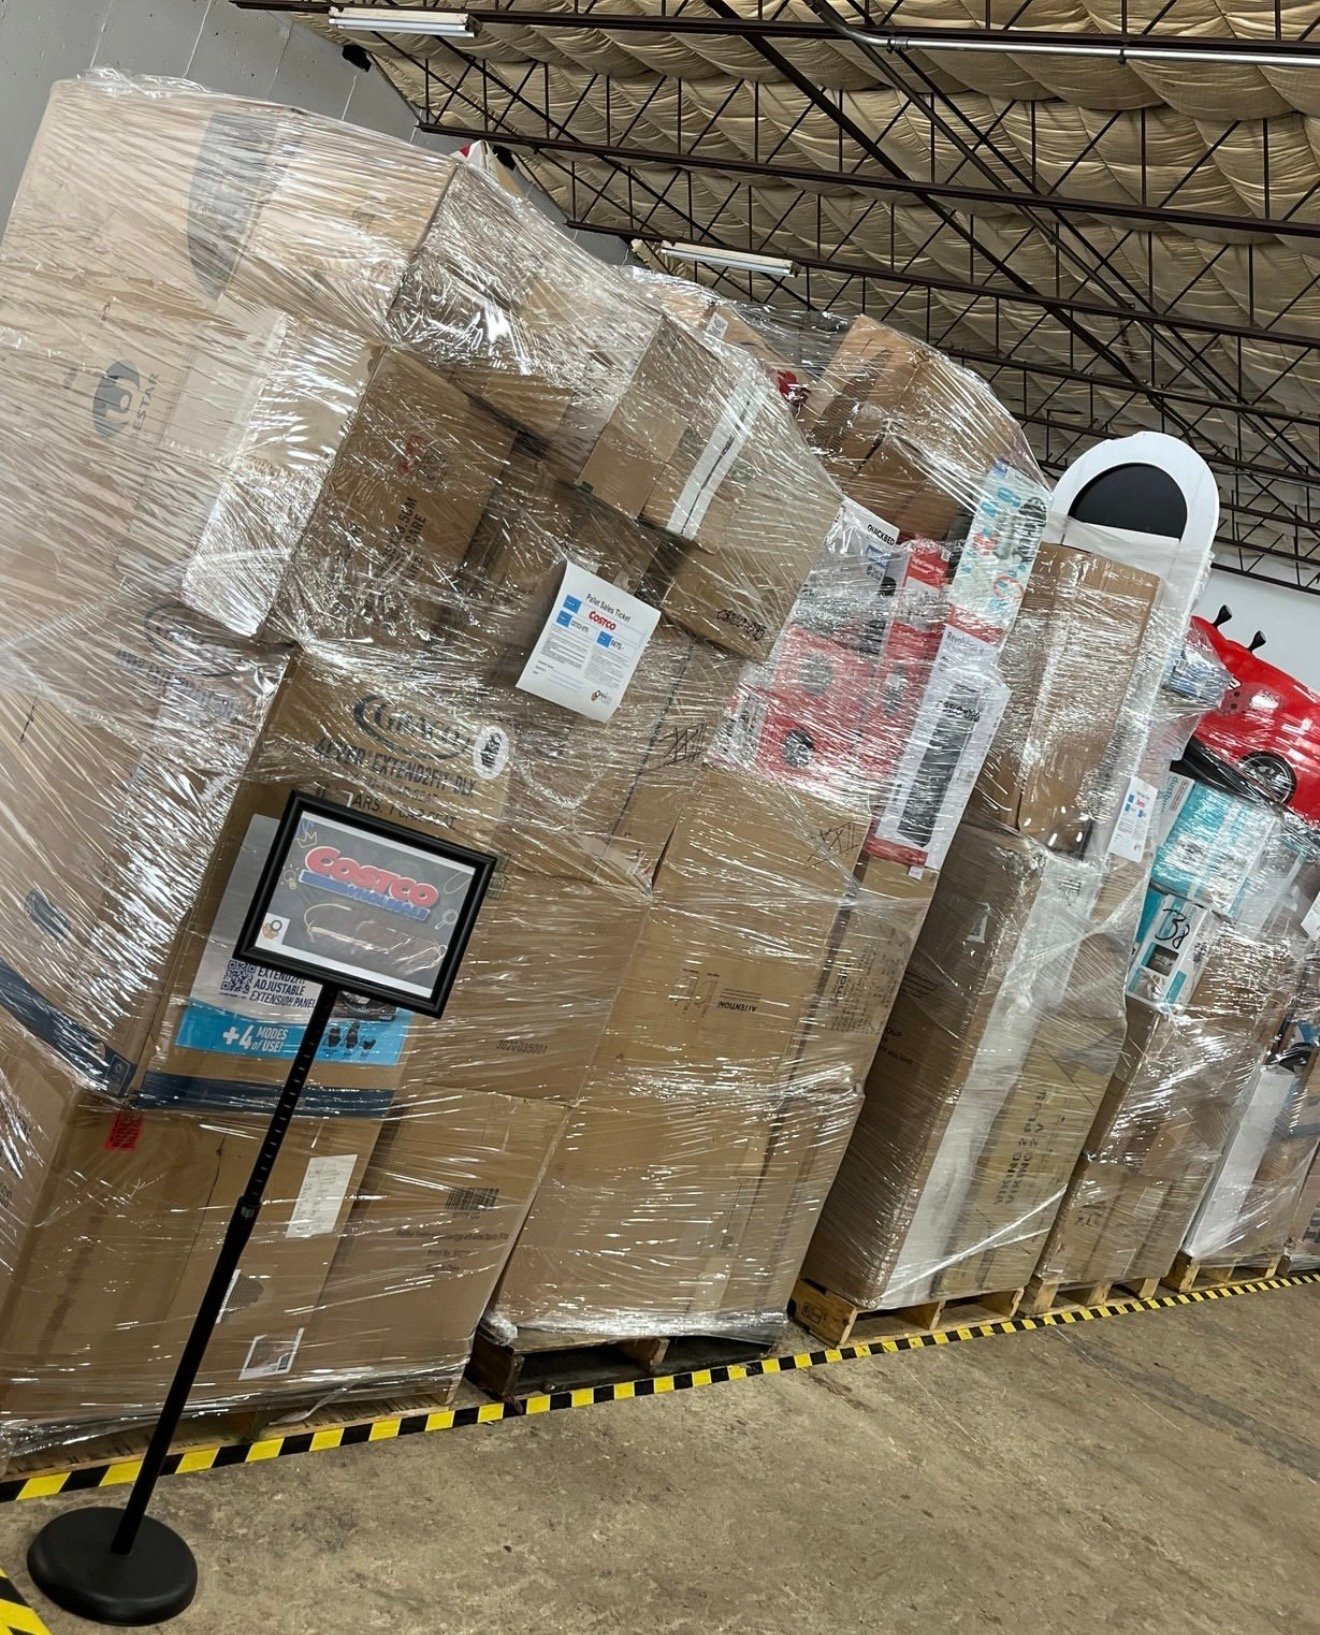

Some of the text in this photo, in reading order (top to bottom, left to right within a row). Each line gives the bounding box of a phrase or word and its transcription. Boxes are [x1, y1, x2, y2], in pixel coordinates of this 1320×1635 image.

[406, 514, 428, 546] CARE
[867, 524, 896, 546] QUICKBED
[586, 593, 632, 621] Pallet Sales Ticket
[588, 611, 617, 631] COSTCO
[305, 846, 439, 908] COSTCO
[249, 992, 292, 1006] EXTENSION
[253, 981, 306, 996] ADJUSTABLE
[222, 1024, 254, 1050] +4
[256, 1026, 289, 1041] MODES
[262, 1039, 284, 1053] USE!
